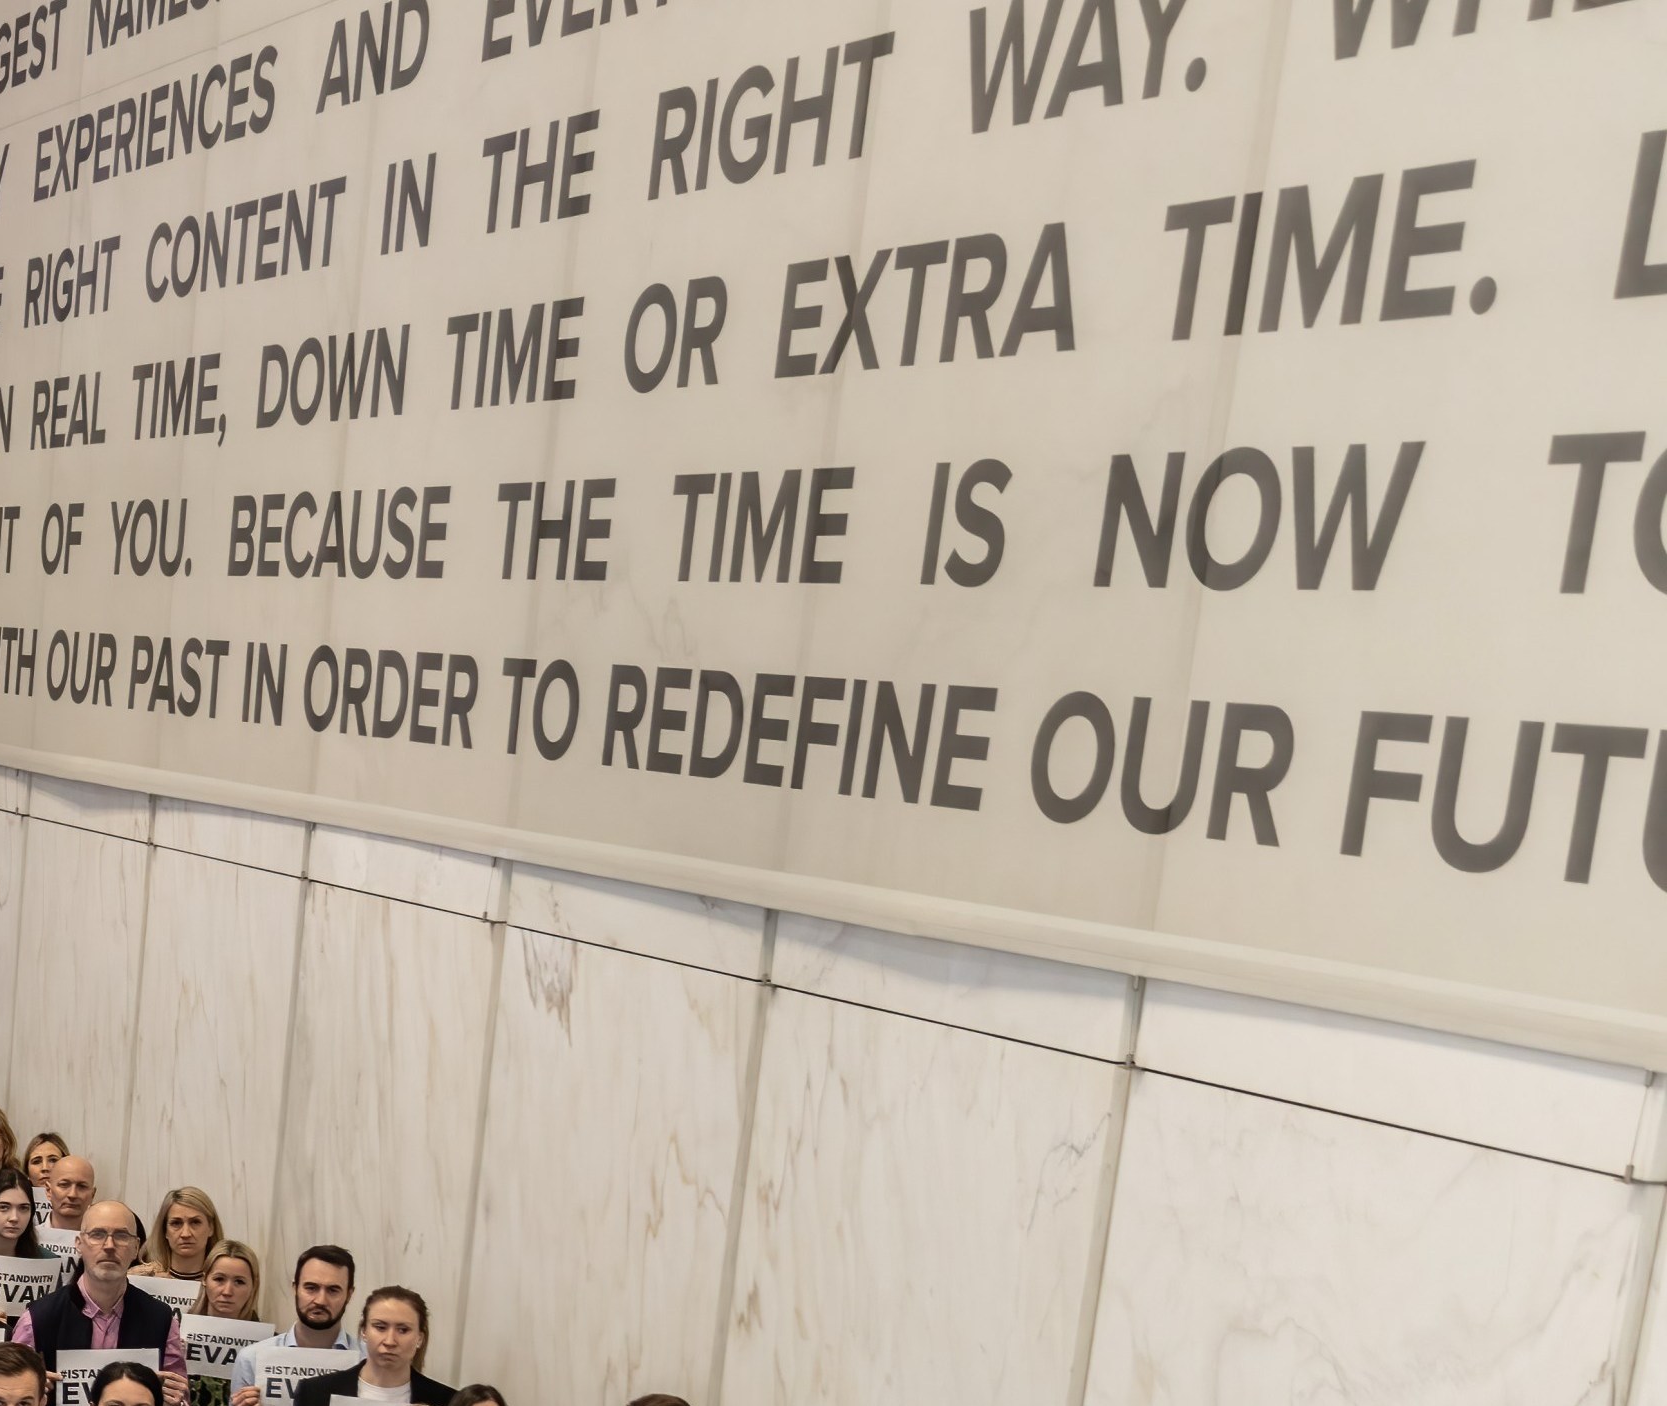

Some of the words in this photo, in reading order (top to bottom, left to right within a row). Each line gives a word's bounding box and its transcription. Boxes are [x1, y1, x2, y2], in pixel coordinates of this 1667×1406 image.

[24, 235, 120, 328] RIGHT
[146, 176, 346, 302] CONTENT
[381, 153, 436, 255] IN
[483, 110, 600, 233] THE
[648, 32, 895, 200] RIGHT
[970, 0, 1206, 133] WAY.
[34, 46, 278, 202] EXPERIENCES
[316, 0, 429, 114] AND
[30, 372, 106, 450] REAL
[133, 353, 226, 447] TIME,
[256, 324, 410, 428] DOWN
[447, 297, 584, 410] TIME
[625, 276, 727, 393] OR
[775, 223, 1075, 378] EXTRA
[1165, 160, 1496, 340] TIME.
[41, 503, 84, 575] OF
[111, 499, 191, 576] YOU.
[228, 486, 451, 579] BECAUSE
[498, 478, 616, 581] THE
[674, 467, 855, 583] TIME
[921, 459, 1012, 587] IS
[1094, 442, 1425, 591] NOW
[47, 630, 117, 706] OUR
[128, 636, 230, 718] PAST
[242, 642, 287, 726] IN
[304, 645, 478, 749] ORDER
[503, 658, 579, 761] TO
[602, 664, 998, 811] REDEFINE
[1031, 691, 1294, 846] OUR
[1341, 711, 1667, 893] FUT
